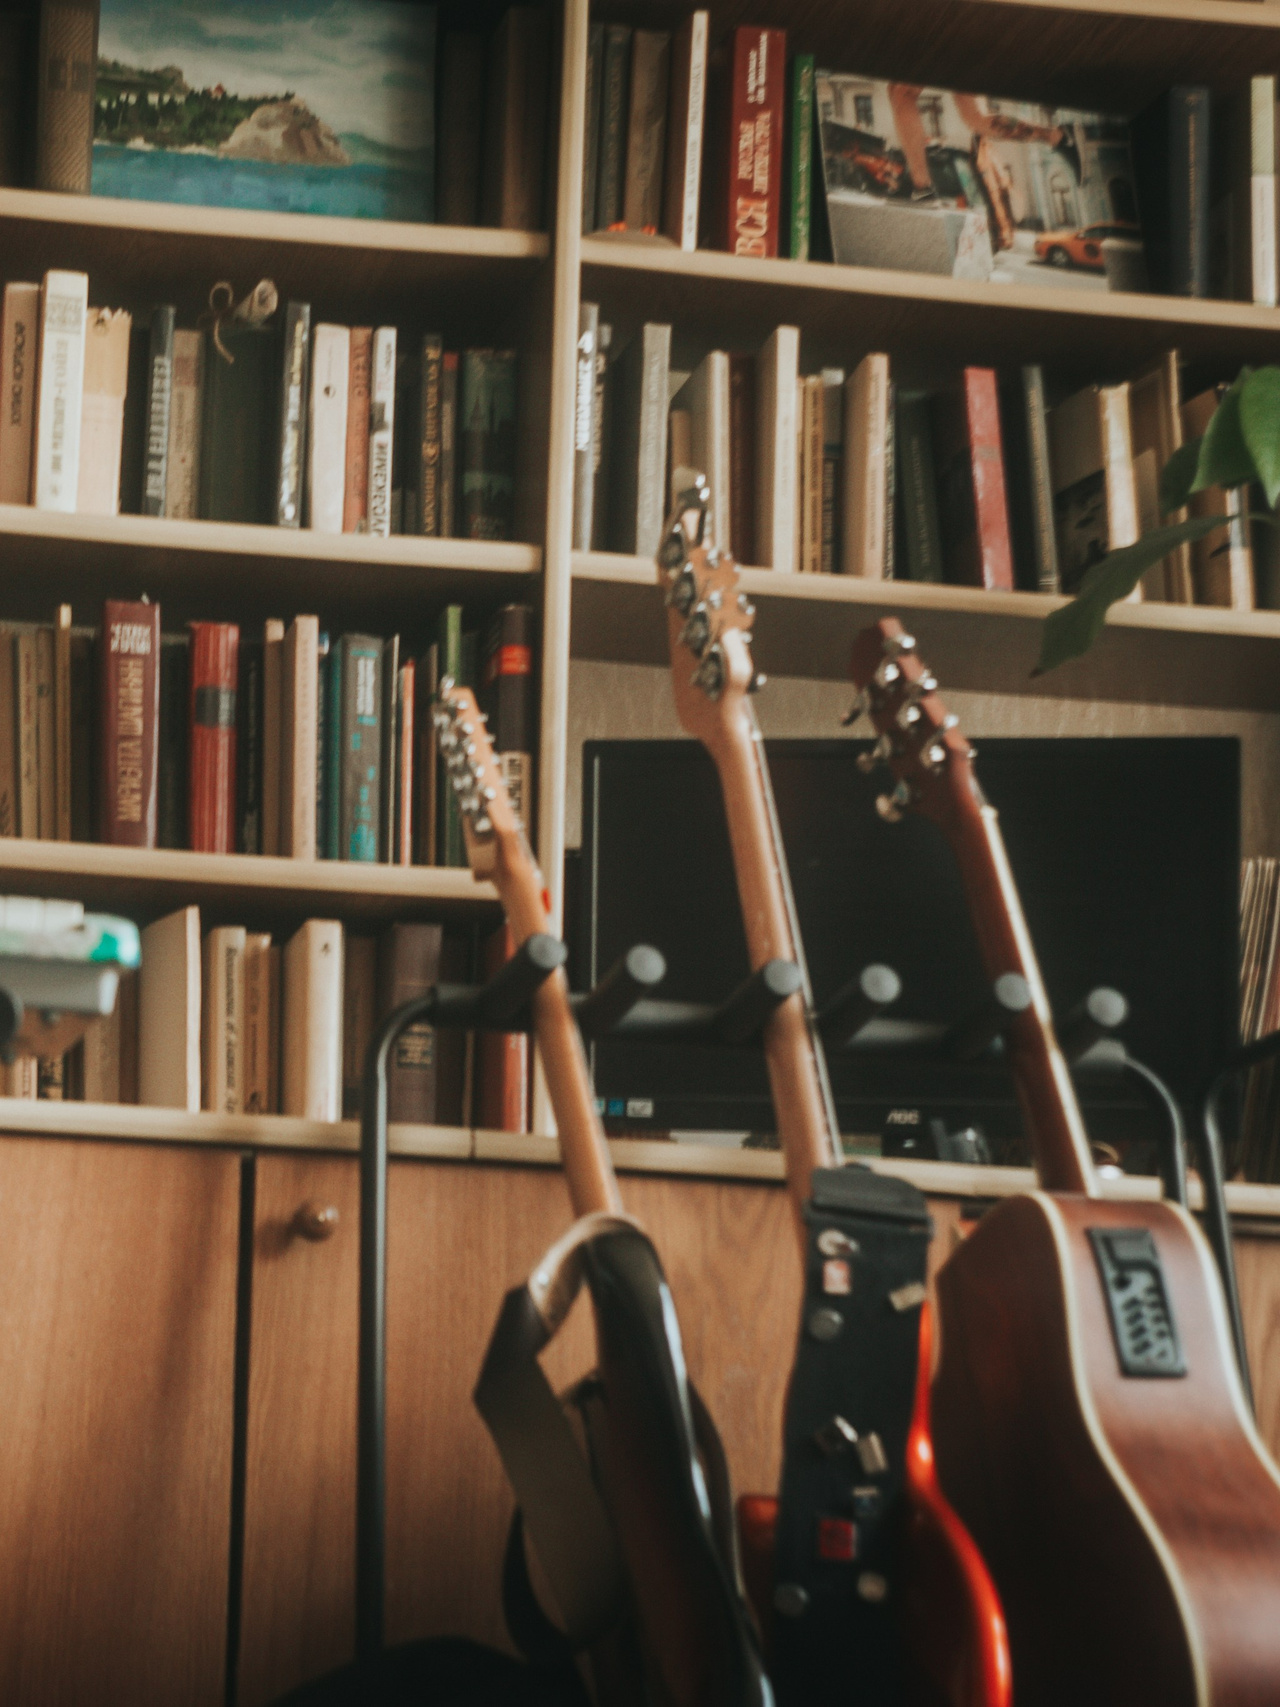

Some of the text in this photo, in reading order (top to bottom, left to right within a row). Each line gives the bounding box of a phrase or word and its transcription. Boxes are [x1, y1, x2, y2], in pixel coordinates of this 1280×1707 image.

[752, 110, 772, 195] ЛИТЕРАТУРА
[734, 196, 769, 256] ВСЯ
[886, 1109, 919, 1126] AOC
